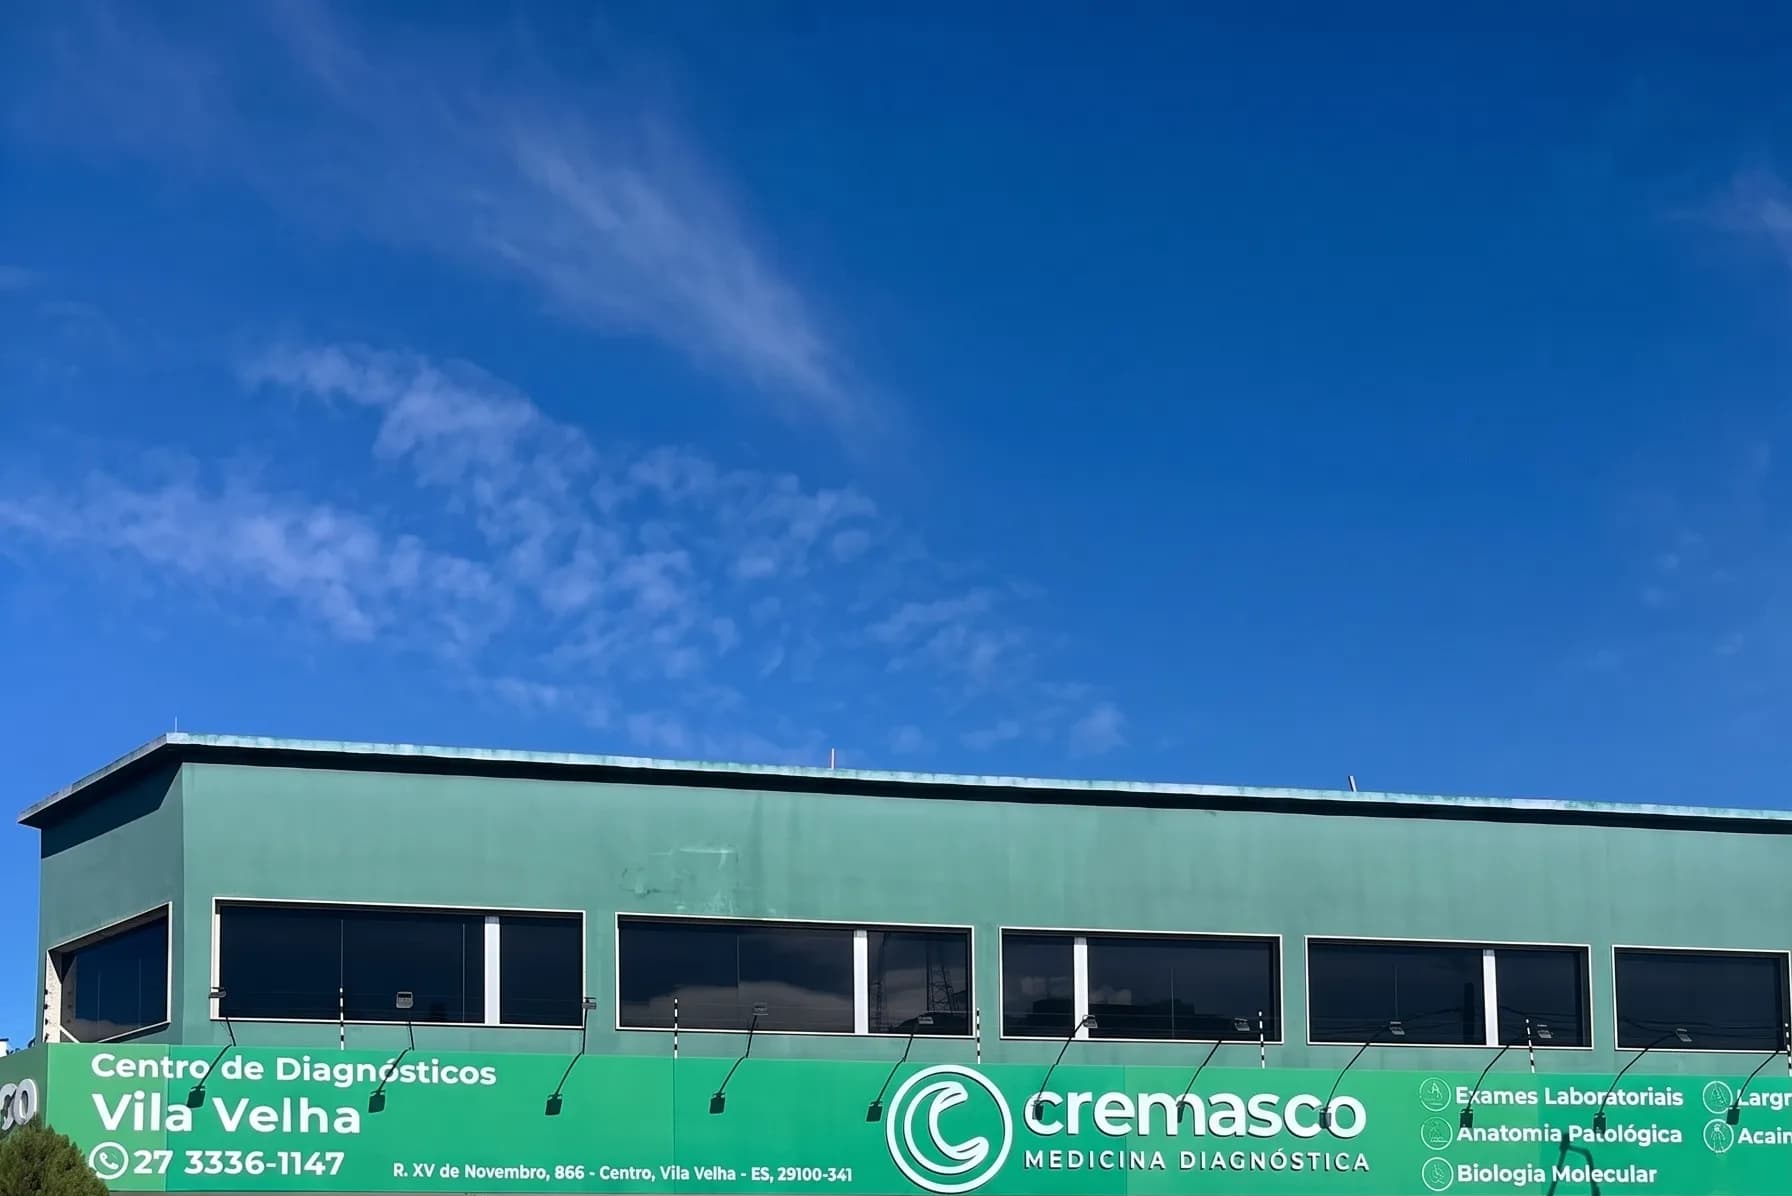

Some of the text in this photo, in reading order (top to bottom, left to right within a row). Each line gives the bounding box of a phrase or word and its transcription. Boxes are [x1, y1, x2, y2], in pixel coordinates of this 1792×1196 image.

[91, 1052, 497, 1089] Centro de Diagnósticos
[1455, 1086, 1684, 1107] Exames Laboratoriais
[92, 1091, 361, 1135] Vila Velha
[1025, 1088, 1367, 1138] cremasco
[1457, 1123, 1683, 1147] Anatomia Patológica
[133, 1149, 345, 1177] 27 3336-1147
[393, 1162, 408, 1177] R.
[413, 1163, 436, 1177] XV
[440, 1164, 460, 1178] de
[464, 1163, 551, 1181] Novembro,
[555, 1165, 585, 1180] 866
[600, 1165, 656, 1182] Centro,
[660, 1165, 690, 1180] Vila
[694, 1165, 736, 1181] Velha
[751, 1166, 774, 1183] ES,
[777, 1167, 853, 1182] 29100-341
[1024, 1149, 1370, 1172] MEDICINA DIAGNÓSTICA
[1457, 1164, 1658, 1186] Biologia Molecular
